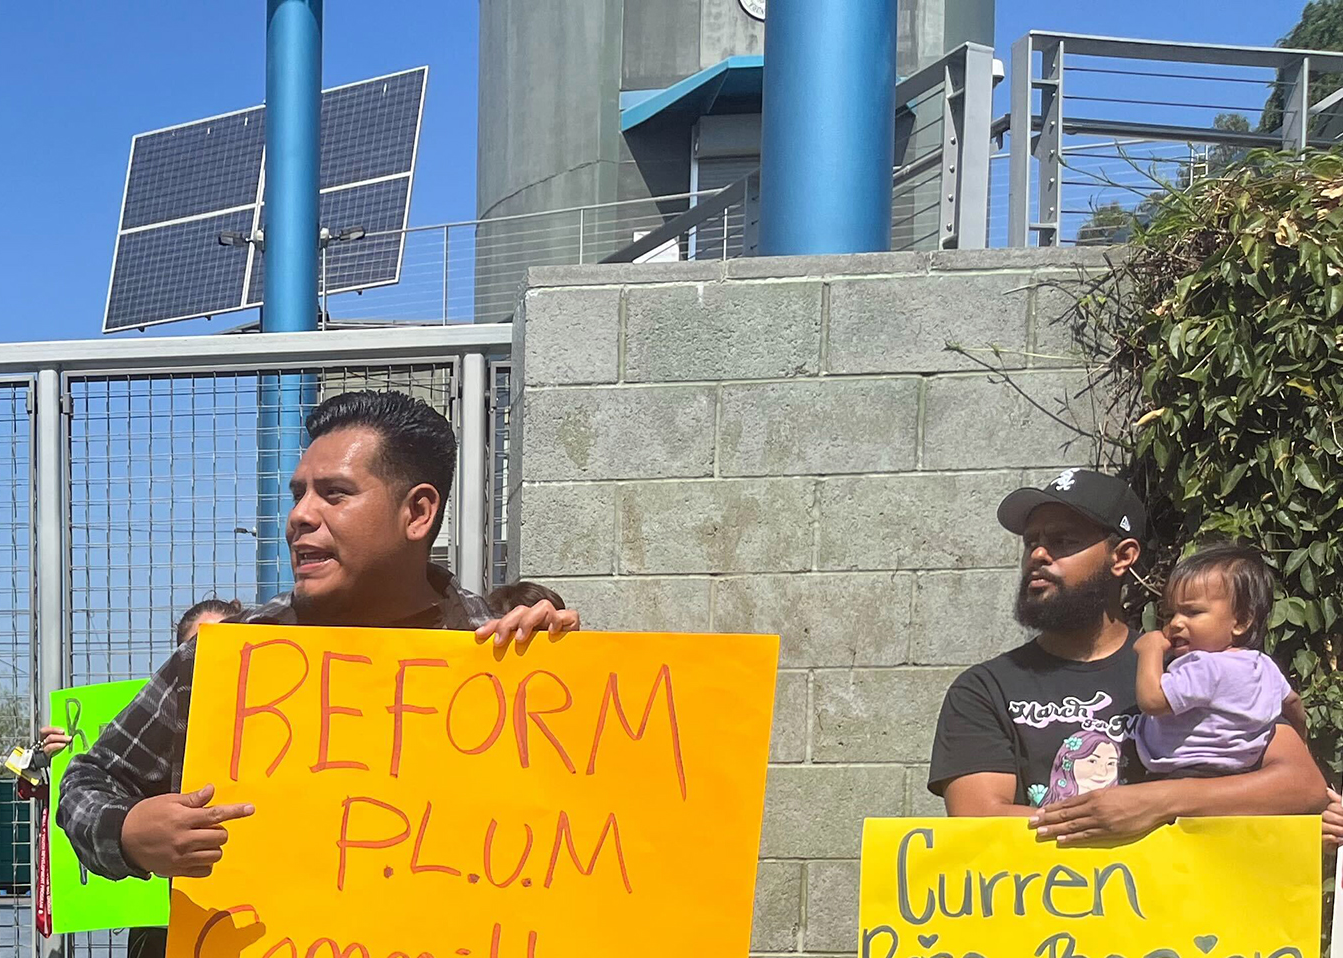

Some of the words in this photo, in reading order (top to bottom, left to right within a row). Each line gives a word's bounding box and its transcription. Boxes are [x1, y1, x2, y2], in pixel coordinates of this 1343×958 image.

[229, 637, 688, 802] REFORM
[1008, 691, 1113, 729] March
[335, 795, 634, 895] P.L.U.M
[897, 828, 1147, 925] Curren
